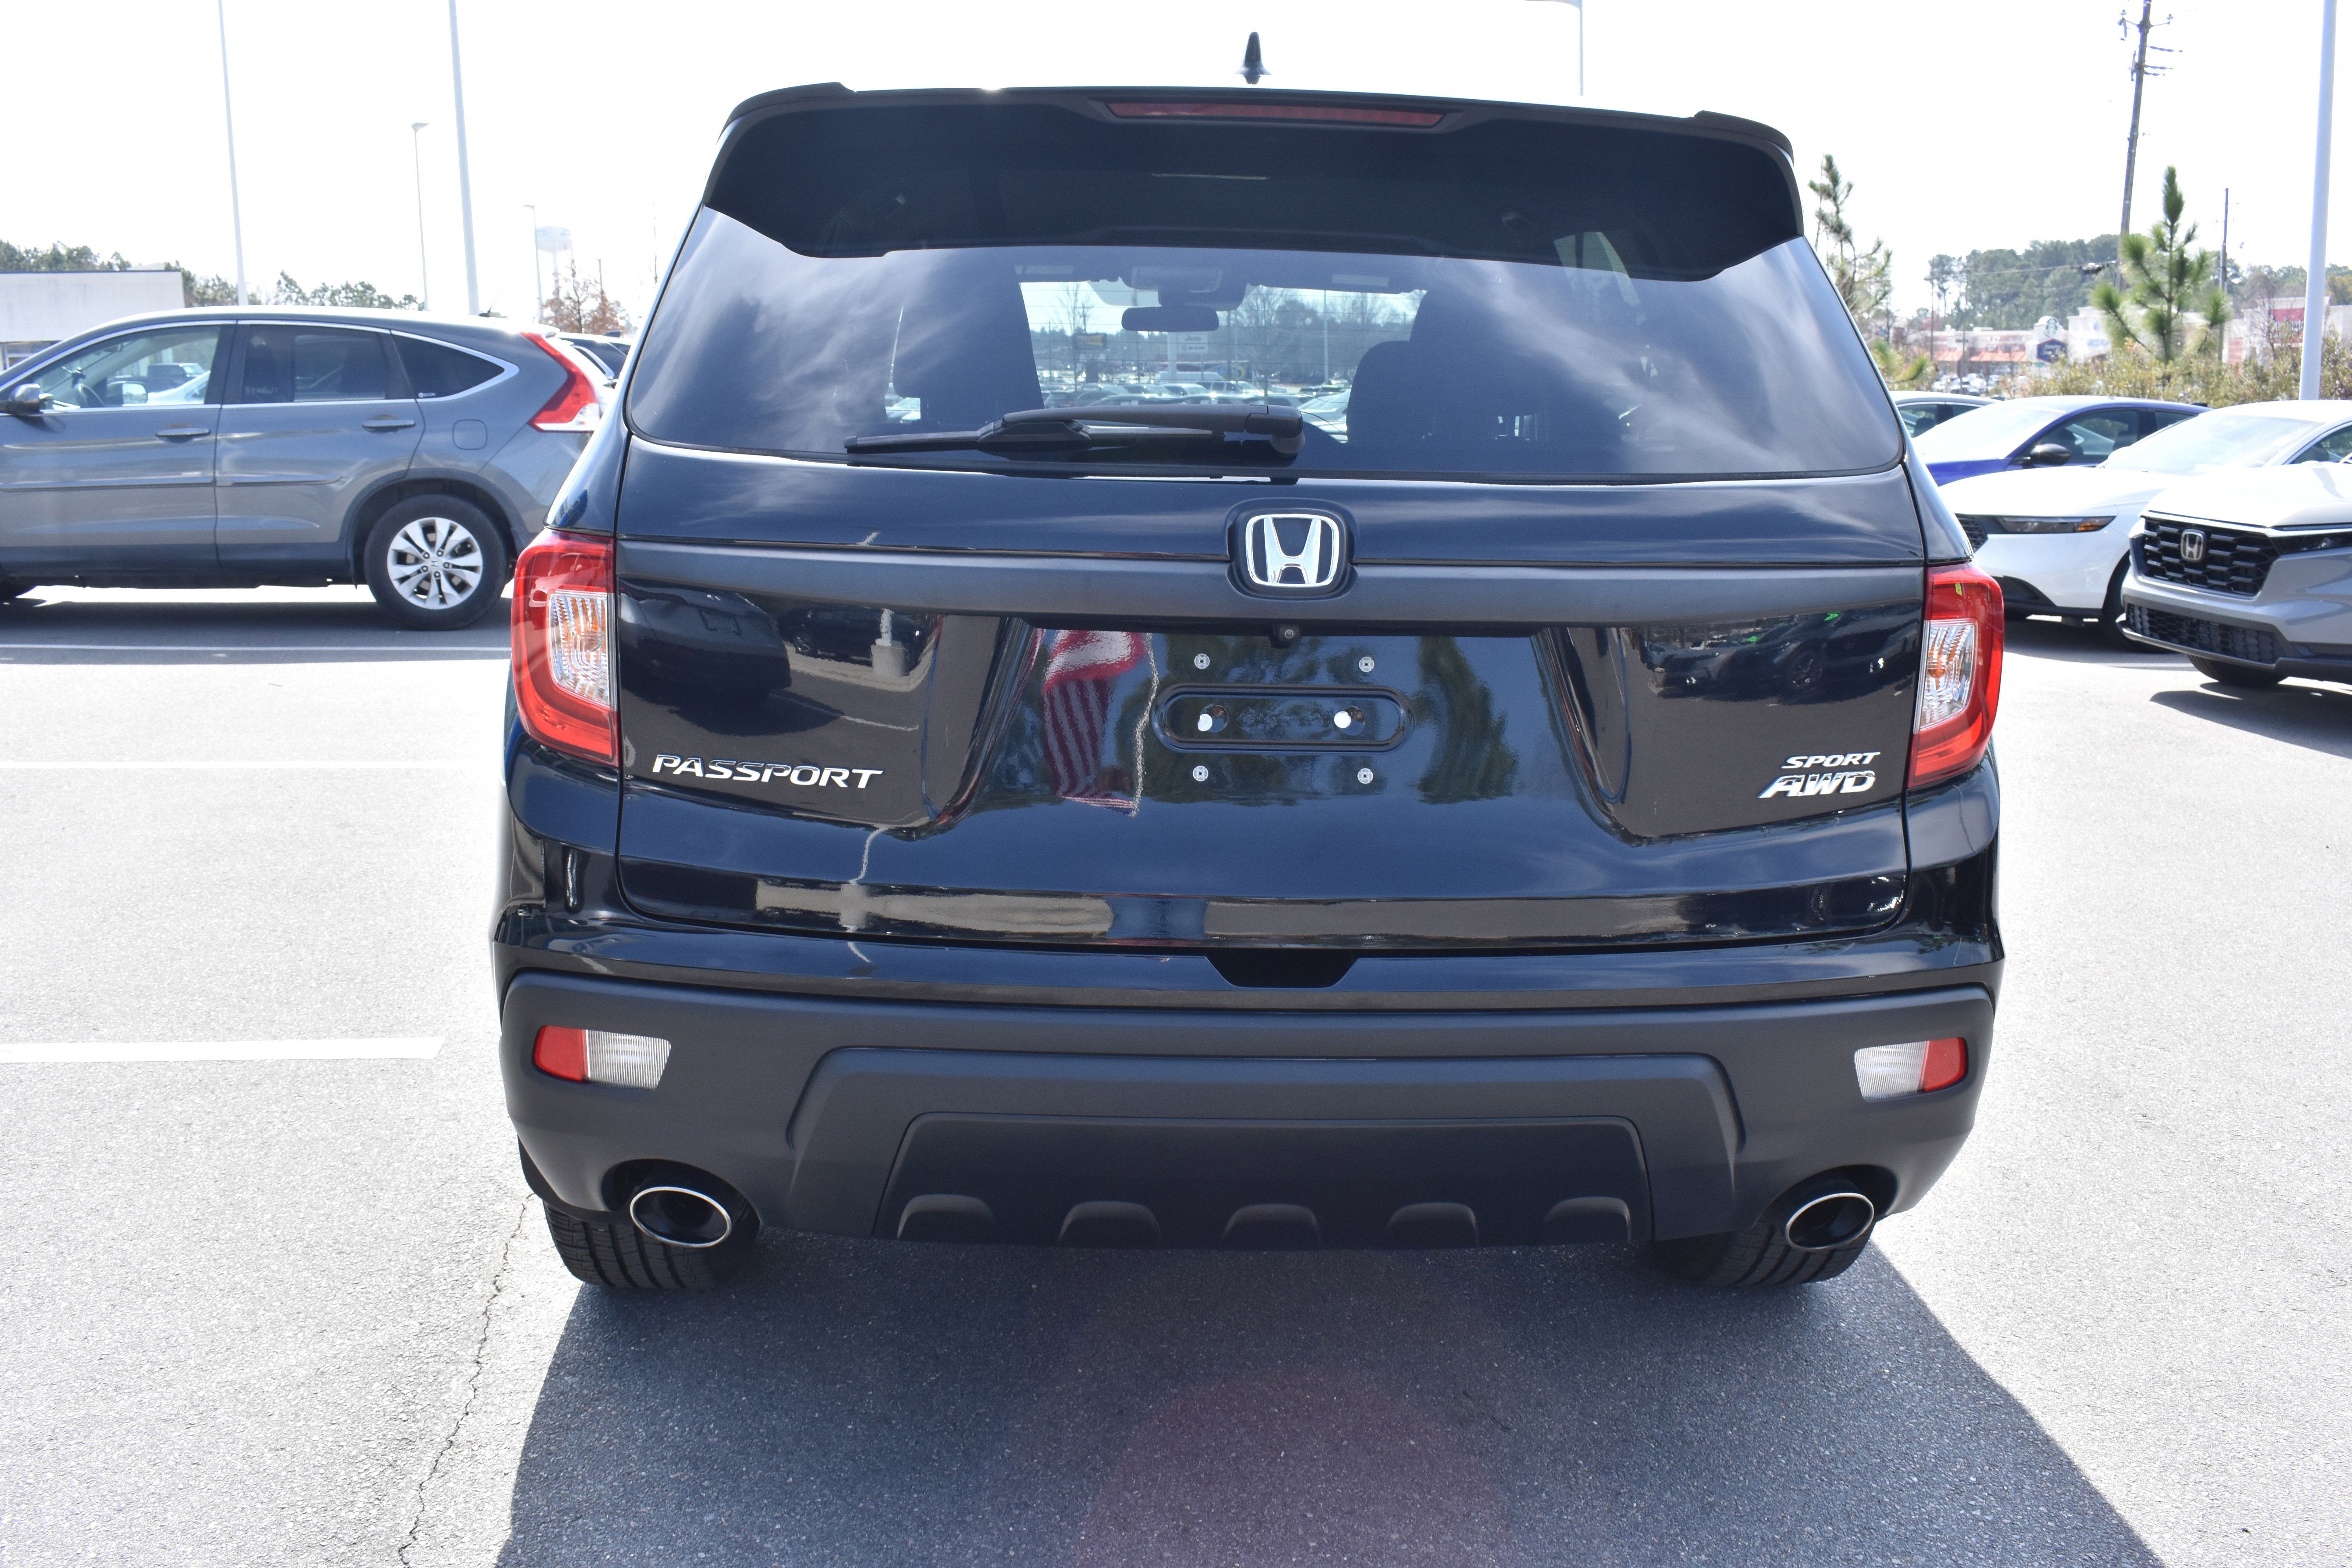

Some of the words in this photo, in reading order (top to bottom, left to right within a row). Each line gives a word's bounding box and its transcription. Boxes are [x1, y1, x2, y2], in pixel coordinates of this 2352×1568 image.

[653, 754, 883, 788] PASSPORT
[1781, 751, 1880, 769] SPORT
[1757, 770, 1876, 799] AWD
